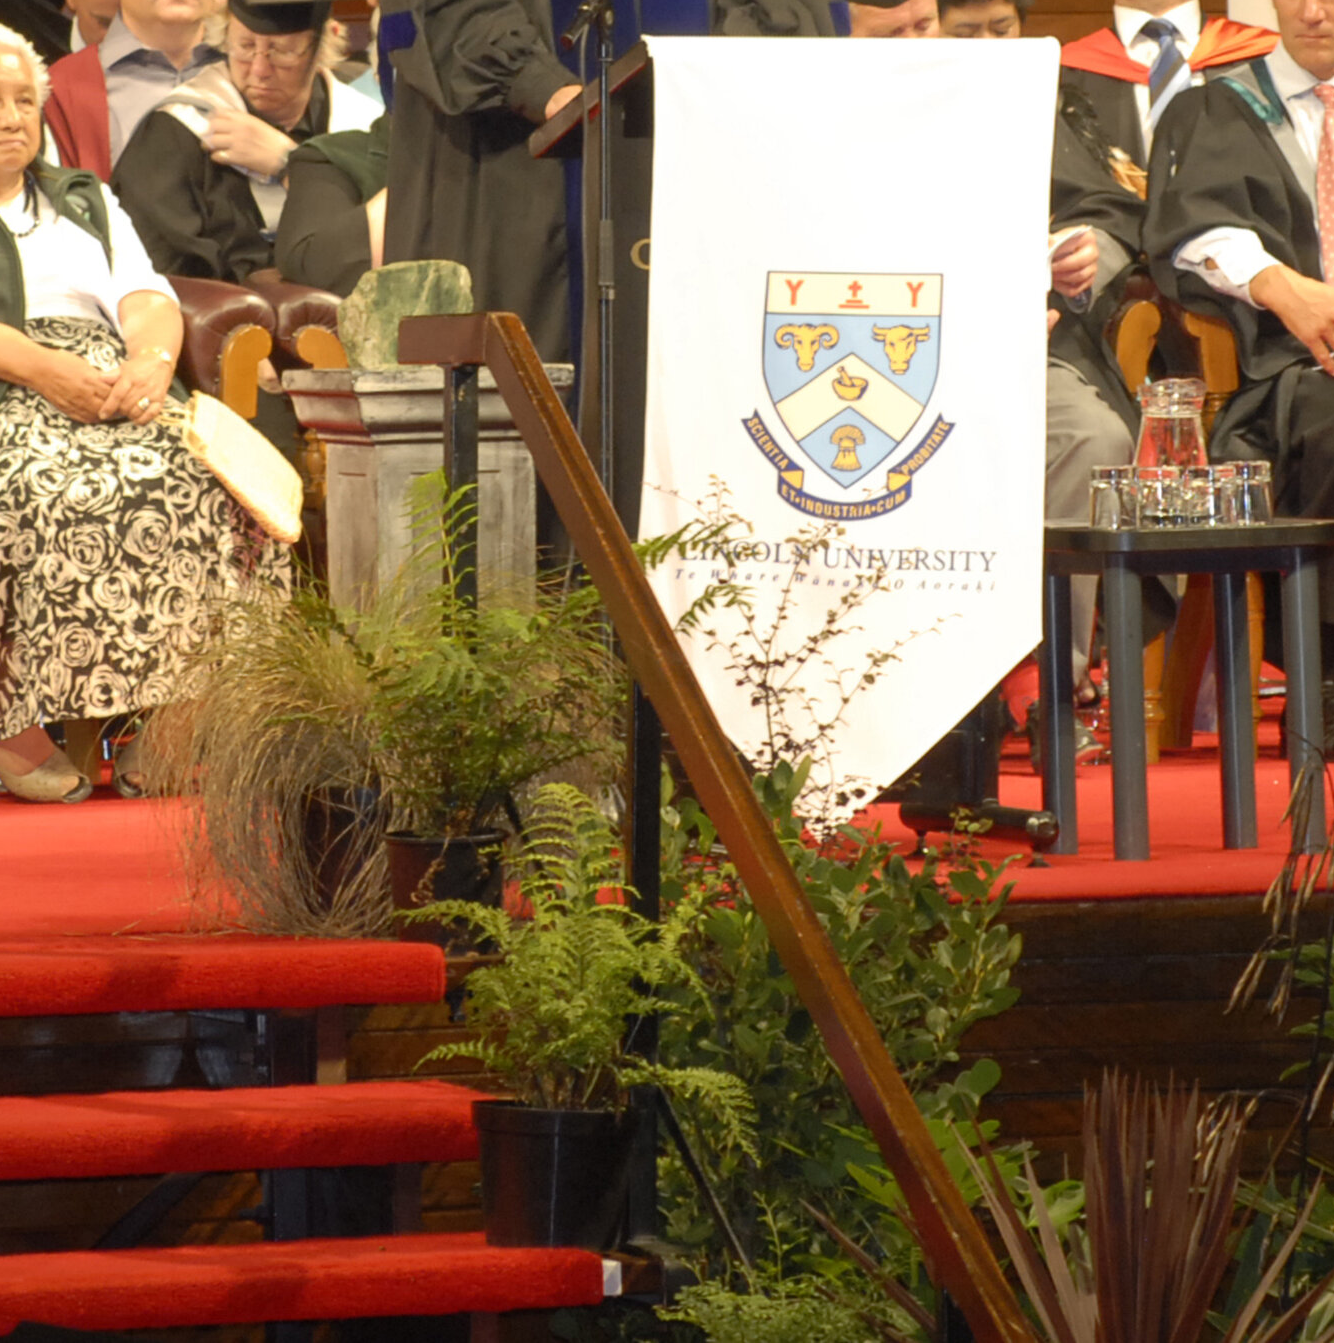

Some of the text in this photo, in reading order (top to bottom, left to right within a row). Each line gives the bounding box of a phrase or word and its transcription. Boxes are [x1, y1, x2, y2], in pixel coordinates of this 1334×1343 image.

[747, 417, 789, 469] SCIENTIA
[900, 420, 951, 475] PROBITATE
[824, 547, 997, 572] UNIVERSITY
